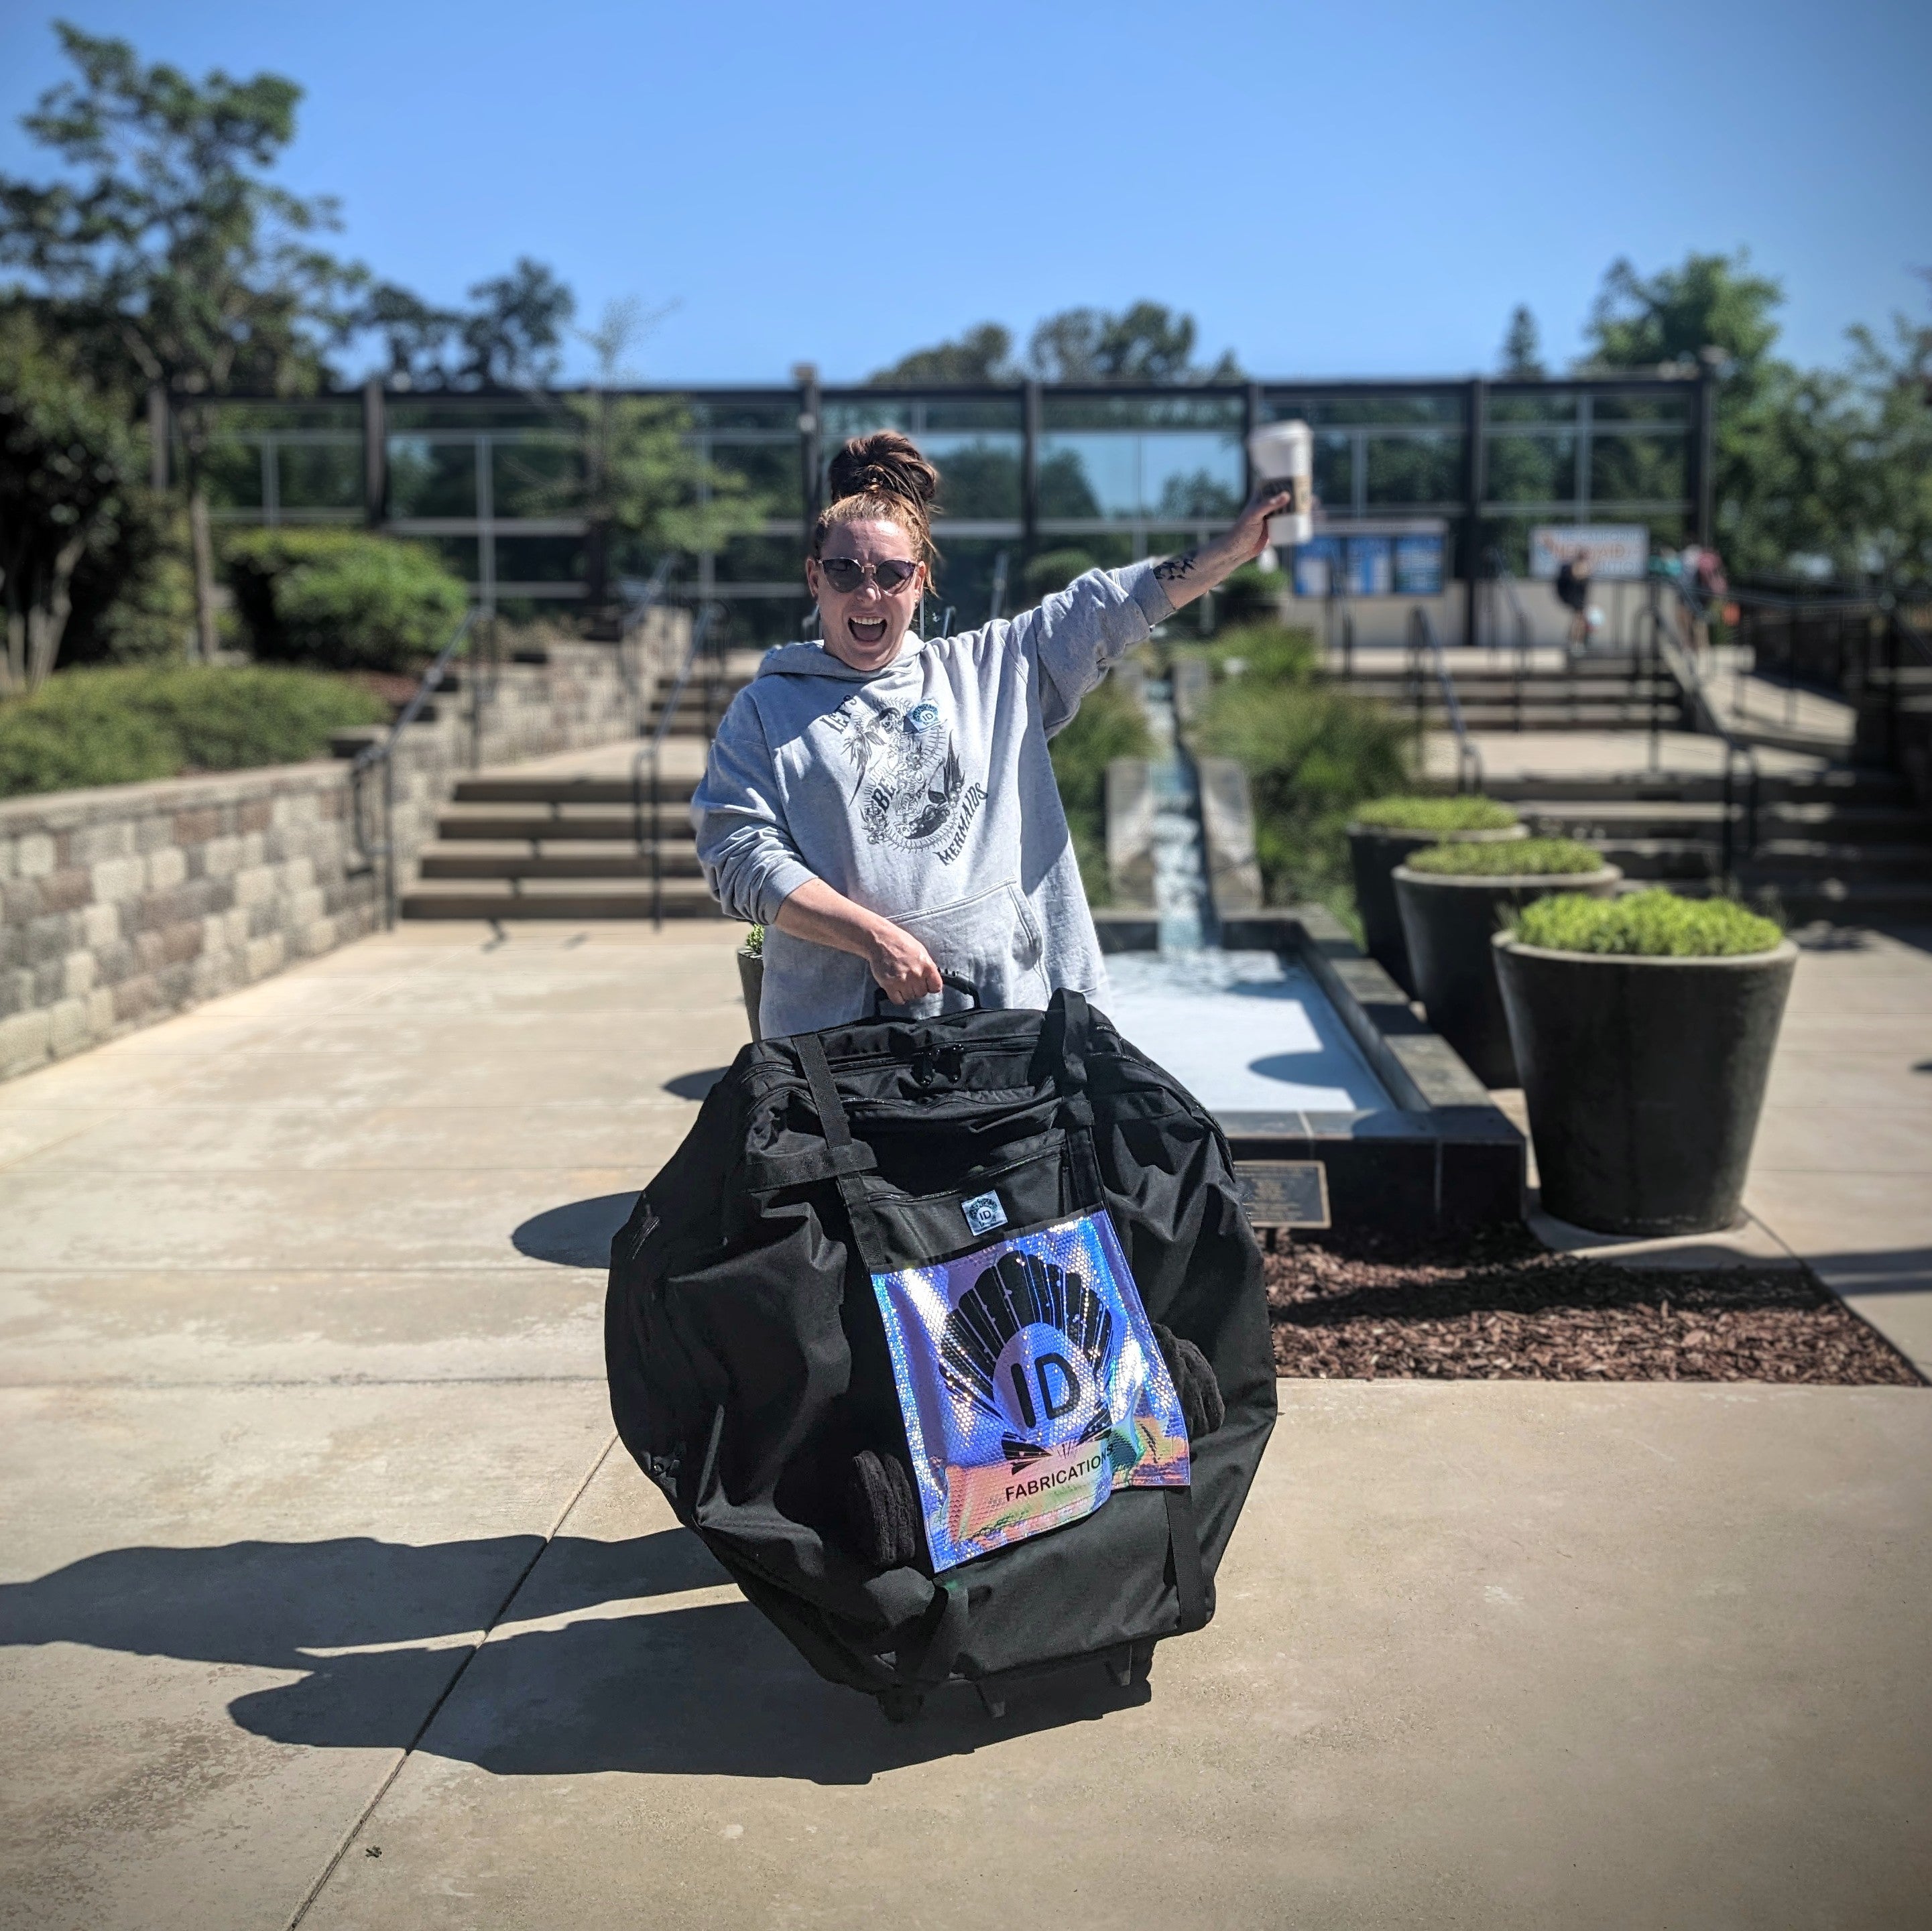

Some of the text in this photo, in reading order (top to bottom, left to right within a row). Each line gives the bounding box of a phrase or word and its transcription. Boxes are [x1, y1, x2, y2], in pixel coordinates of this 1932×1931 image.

[922, 712, 934, 722] ID
[871, 775, 896, 813] BE
[932, 782, 989, 866] MERMAIDS
[979, 1210, 991, 1221] ID
[1010, 1352, 1081, 1428] ID
[1005, 1443, 1113, 1501] FABRICATIONS
